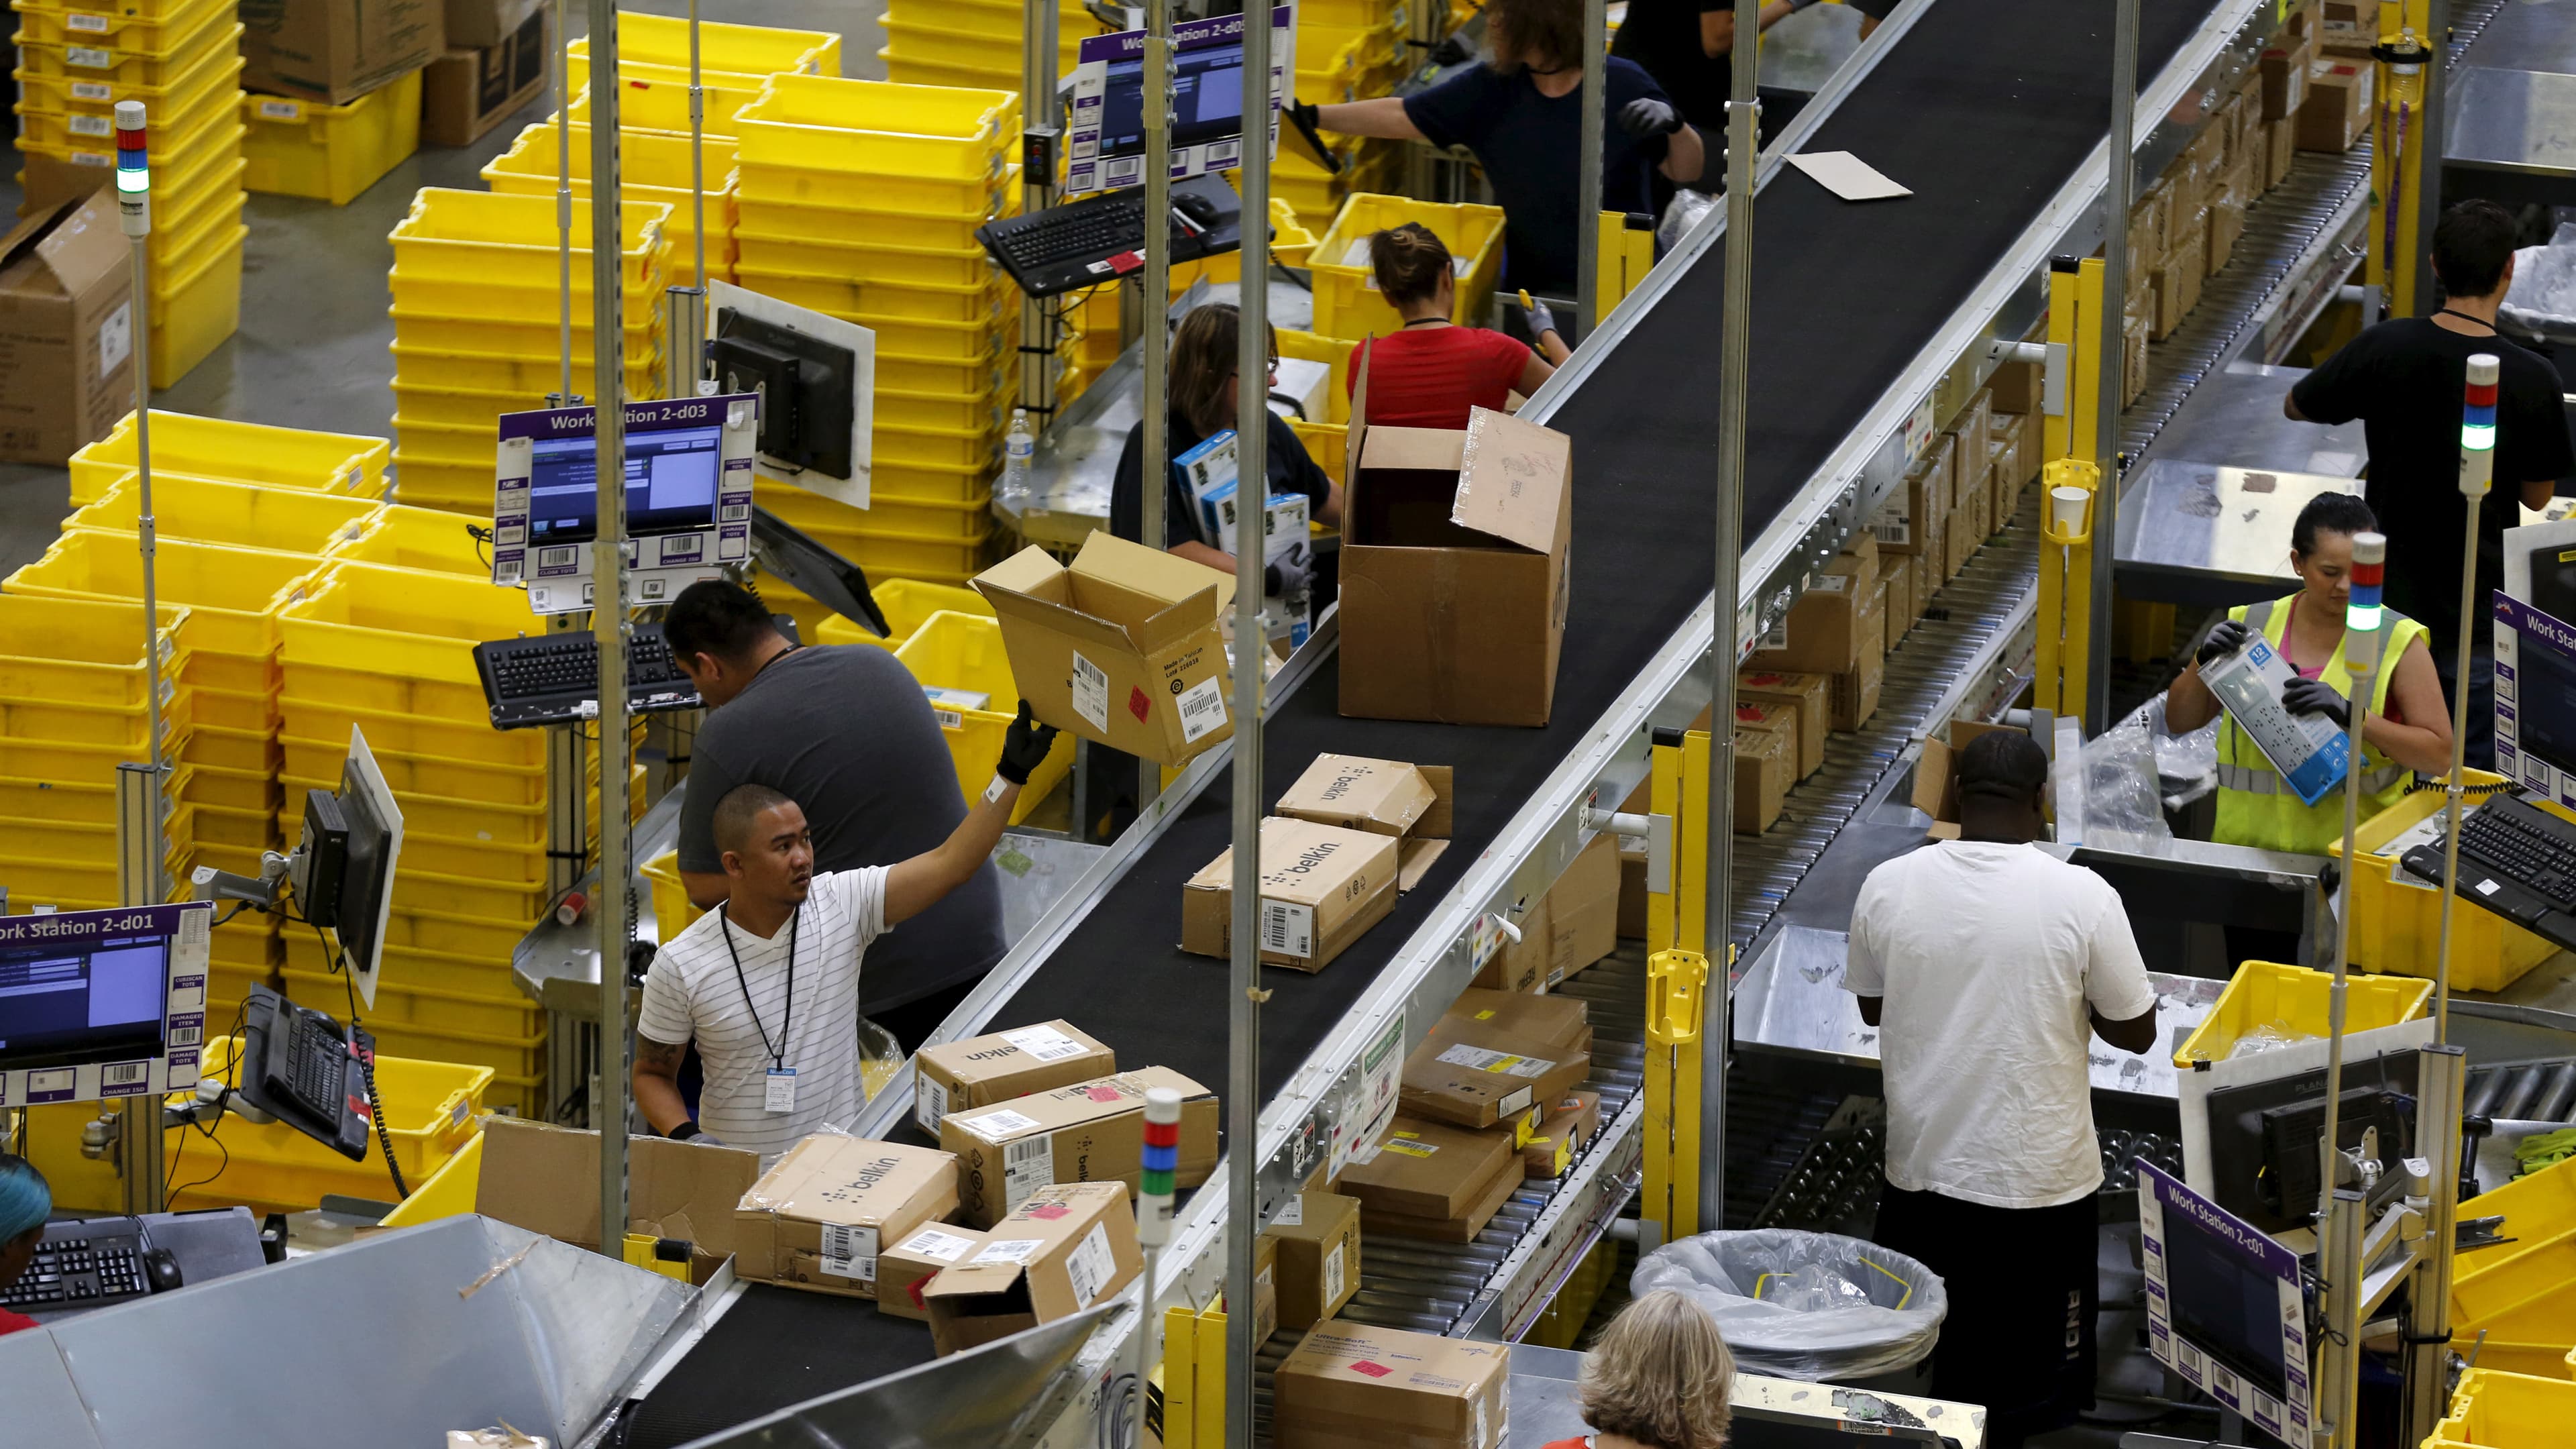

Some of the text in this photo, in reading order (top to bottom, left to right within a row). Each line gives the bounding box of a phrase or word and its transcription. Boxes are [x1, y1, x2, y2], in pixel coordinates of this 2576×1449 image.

[1122, 36, 1143, 50] Wo
[1173, 28, 1210, 43] ation
[551, 404, 708, 429] Work tion 2-d03
[2526, 613, 2576, 651] Work Stat
[2251, 647, 2266, 659] 12
[1164, 661, 1178, 671] Made
[1166, 669, 1178, 678] Lot#
[1320, 776, 1358, 800] belkin
[1284, 843, 1340, 873] belkin
[0, 914, 154, 939] ork Station 2-d01
[967, 1045, 1020, 1061] elkin
[103, 1088, 131, 1096] CHANGE
[2295, 1079, 2328, 1092] PLANA
[844, 1157, 900, 1189] belkin
[1078, 1155, 1089, 1183] belk
[2168, 1185, 2265, 1258] Work Station 2-c01
[1315, 1333, 1365, 1344] Ultra-Soft
